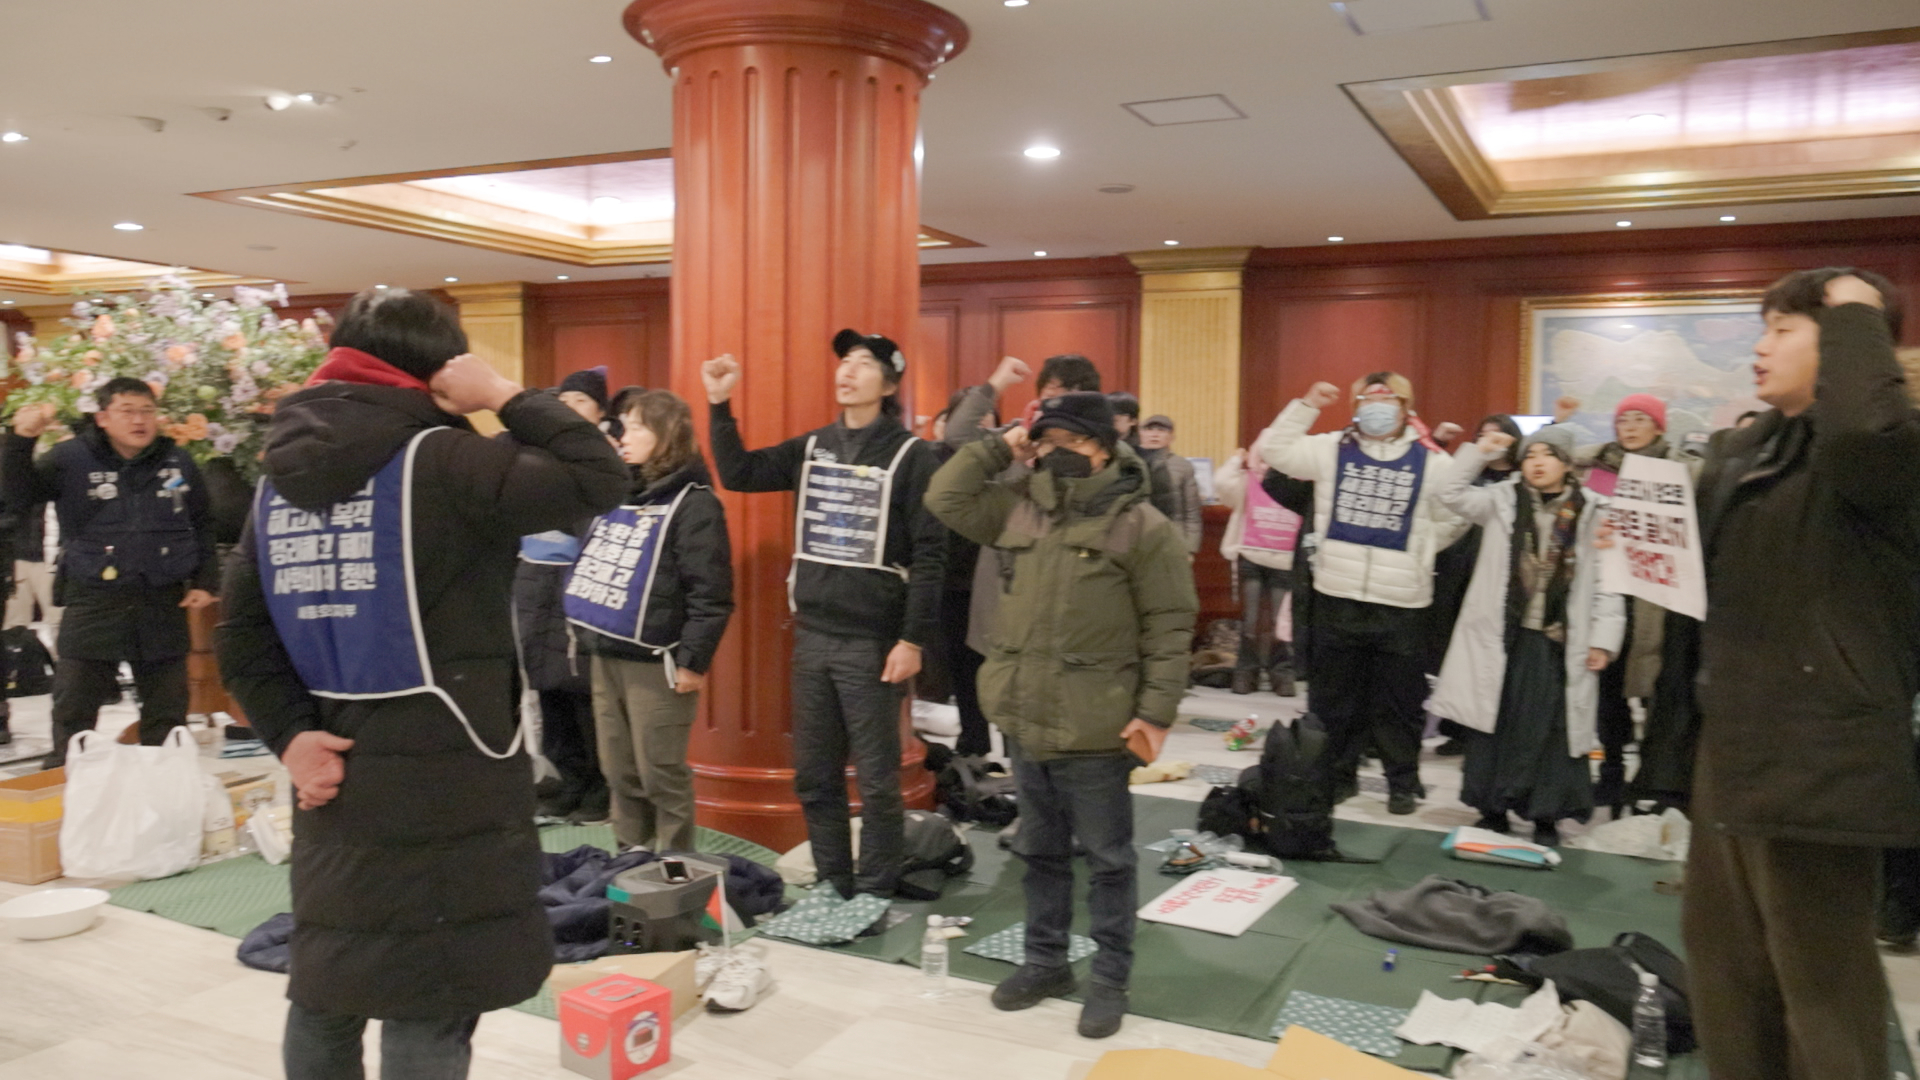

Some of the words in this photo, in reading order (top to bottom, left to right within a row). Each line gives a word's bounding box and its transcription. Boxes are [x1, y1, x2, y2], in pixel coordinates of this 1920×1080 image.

[330, 499, 375, 529] 복직
[268, 533, 334, 565] 정리해고
[273, 563, 336, 594] 사학비리
[340, 562, 377, 590] 청산
